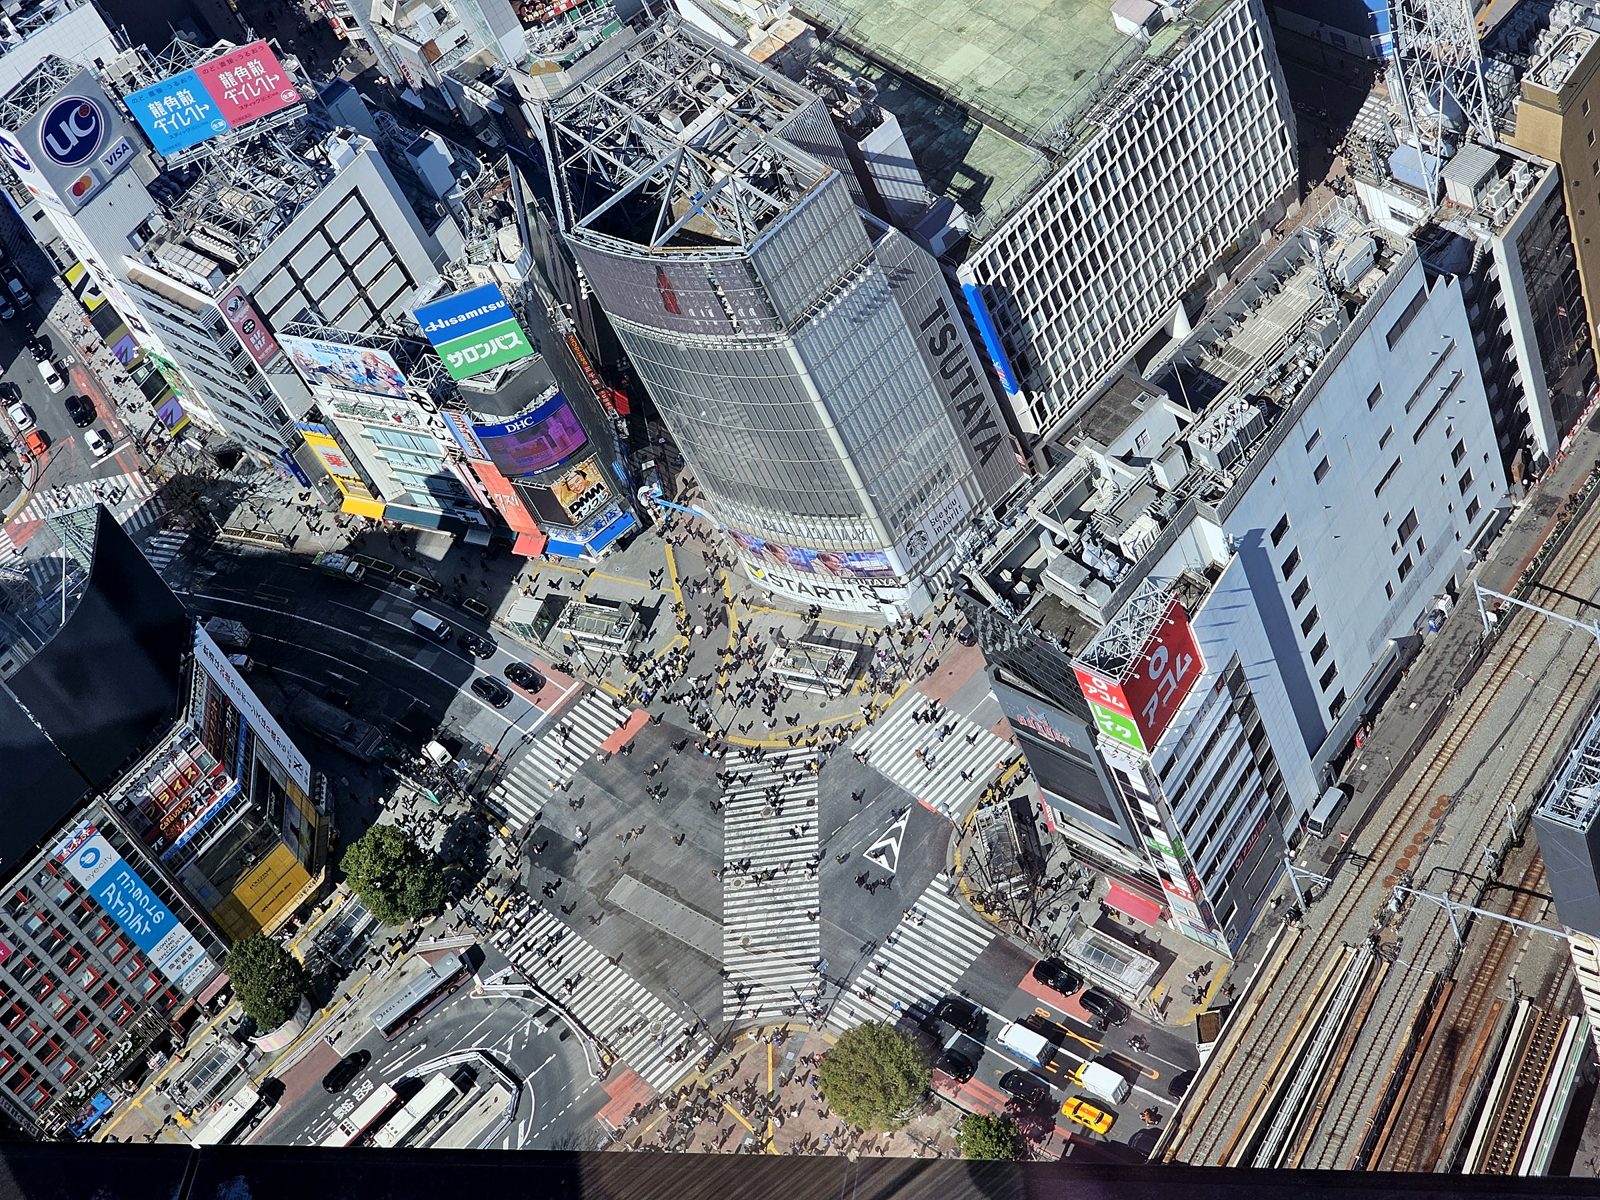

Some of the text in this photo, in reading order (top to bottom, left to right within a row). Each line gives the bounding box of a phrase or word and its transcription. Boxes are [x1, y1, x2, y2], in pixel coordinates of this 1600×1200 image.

[218, 59, 267, 89] 龍角散
[148, 89, 196, 118] 龍角散
[224, 74, 280, 105] ダイレクト
[154, 104, 210, 134] ダイレクト
[104, 143, 130, 166] VISA
[425, 300, 505, 332] Hisamitsu
[447, 331, 523, 368] サロンパス
[919, 297, 1002, 467] TSUTAYA
[505, 416, 534, 433] DHC
[568, 482, 604, 514] DMM
[930, 499, 957, 527] See you
[934, 526, 942, 535] in
[767, 572, 854, 601] START!
[842, 578, 896, 587] TSUTAYA
[1084, 682, 1125, 709] アコム
[1142, 653, 1193, 728] アコム
[1094, 705, 1131, 738] レイク
[117, 798, 130, 812] 9F
[151, 837, 164, 851] 7F
[84, 854, 113, 882] eyecity
[100, 882, 151, 936] アイシティ
[117, 871, 165, 924] コンタクトの
[156, 931, 177, 952] CONTACT
[72, 1040, 133, 1099] サンドラッグ
